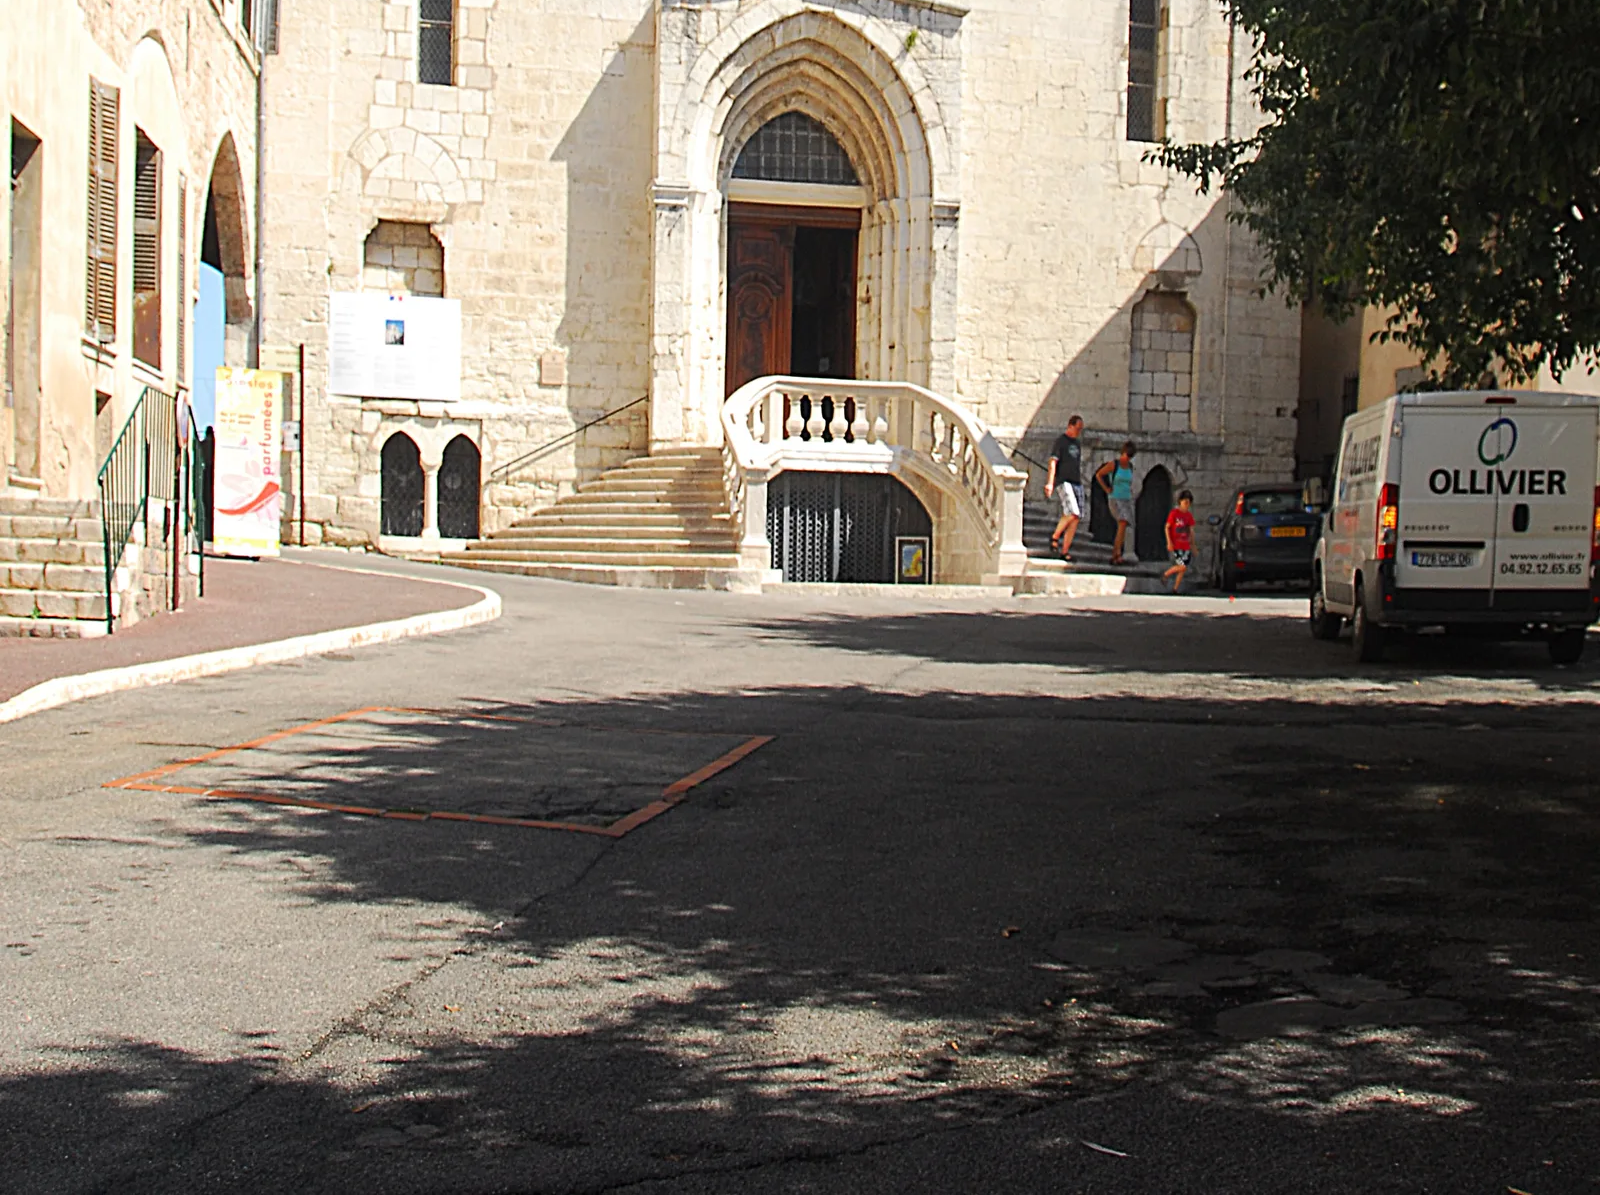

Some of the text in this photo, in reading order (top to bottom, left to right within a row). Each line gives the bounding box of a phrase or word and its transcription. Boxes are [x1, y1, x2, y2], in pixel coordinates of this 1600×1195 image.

[259, 392, 274, 476] parfumées
[1429, 469, 1566, 495] OLLIVIER
[1510, 552, 1586, 561] www.ollivier.fr
[1500, 563, 1582, 575] 04.92.12.65.65
